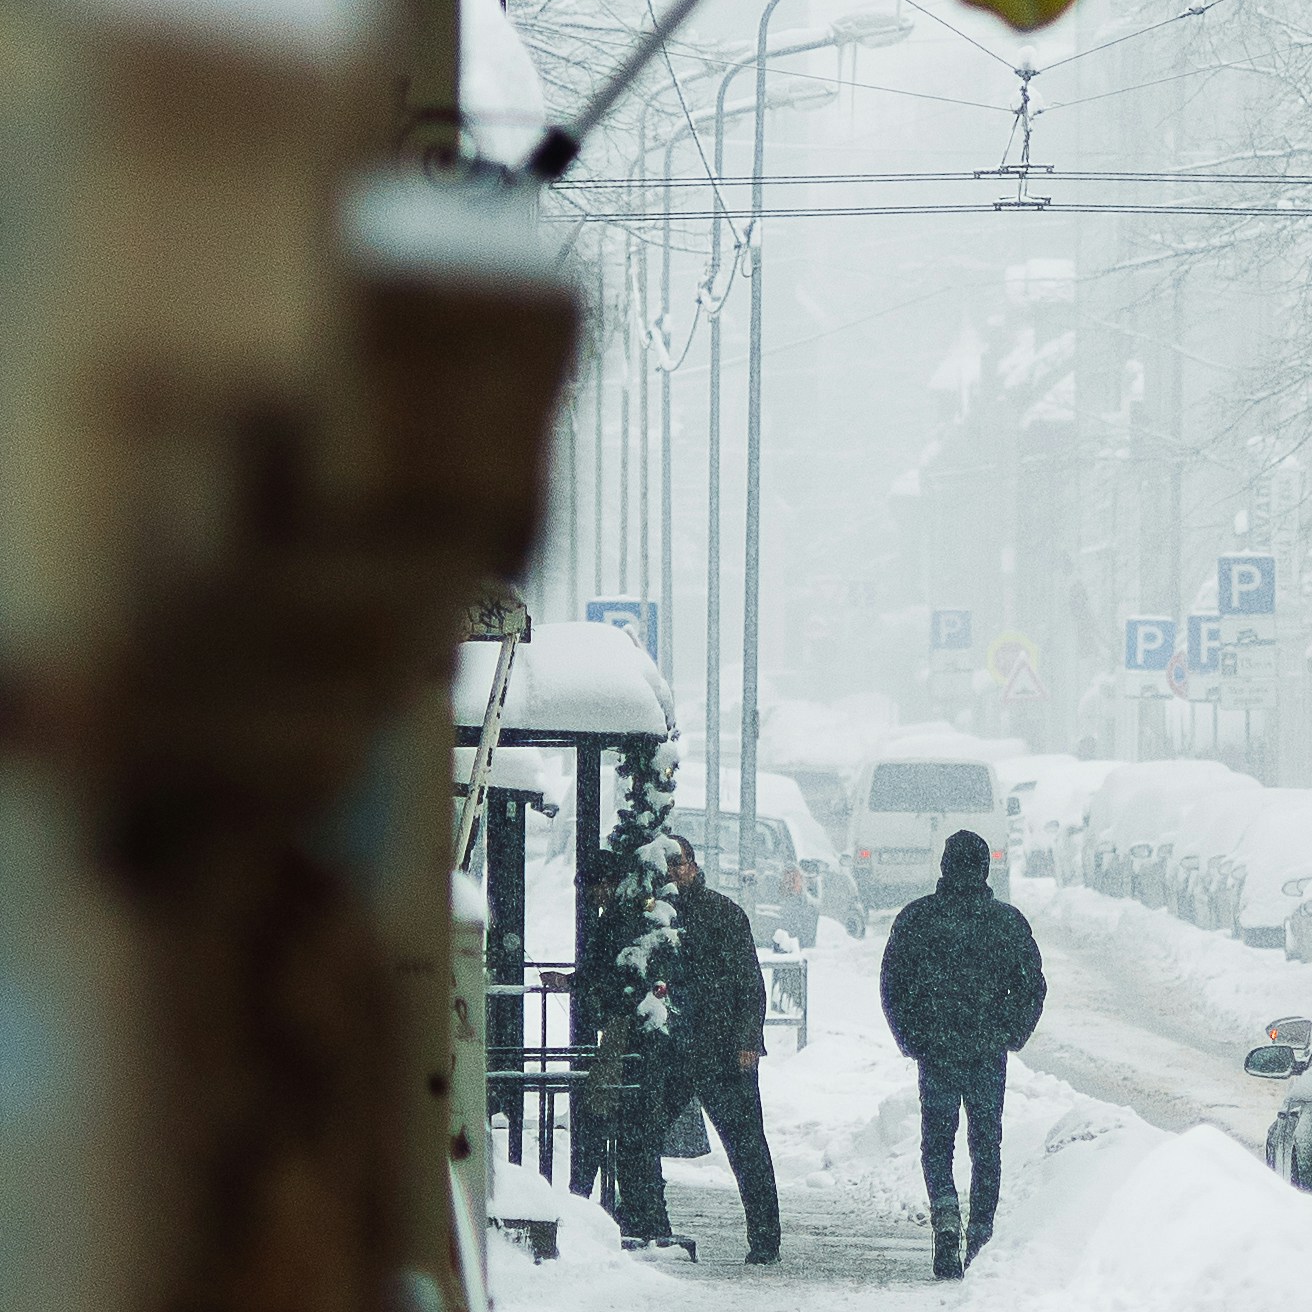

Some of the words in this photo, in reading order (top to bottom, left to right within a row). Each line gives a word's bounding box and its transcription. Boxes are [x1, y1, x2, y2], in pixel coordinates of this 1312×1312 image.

[1231, 564, 1262, 608] P
[939, 615, 961, 645] P
[1136, 625, 1164, 665] P
